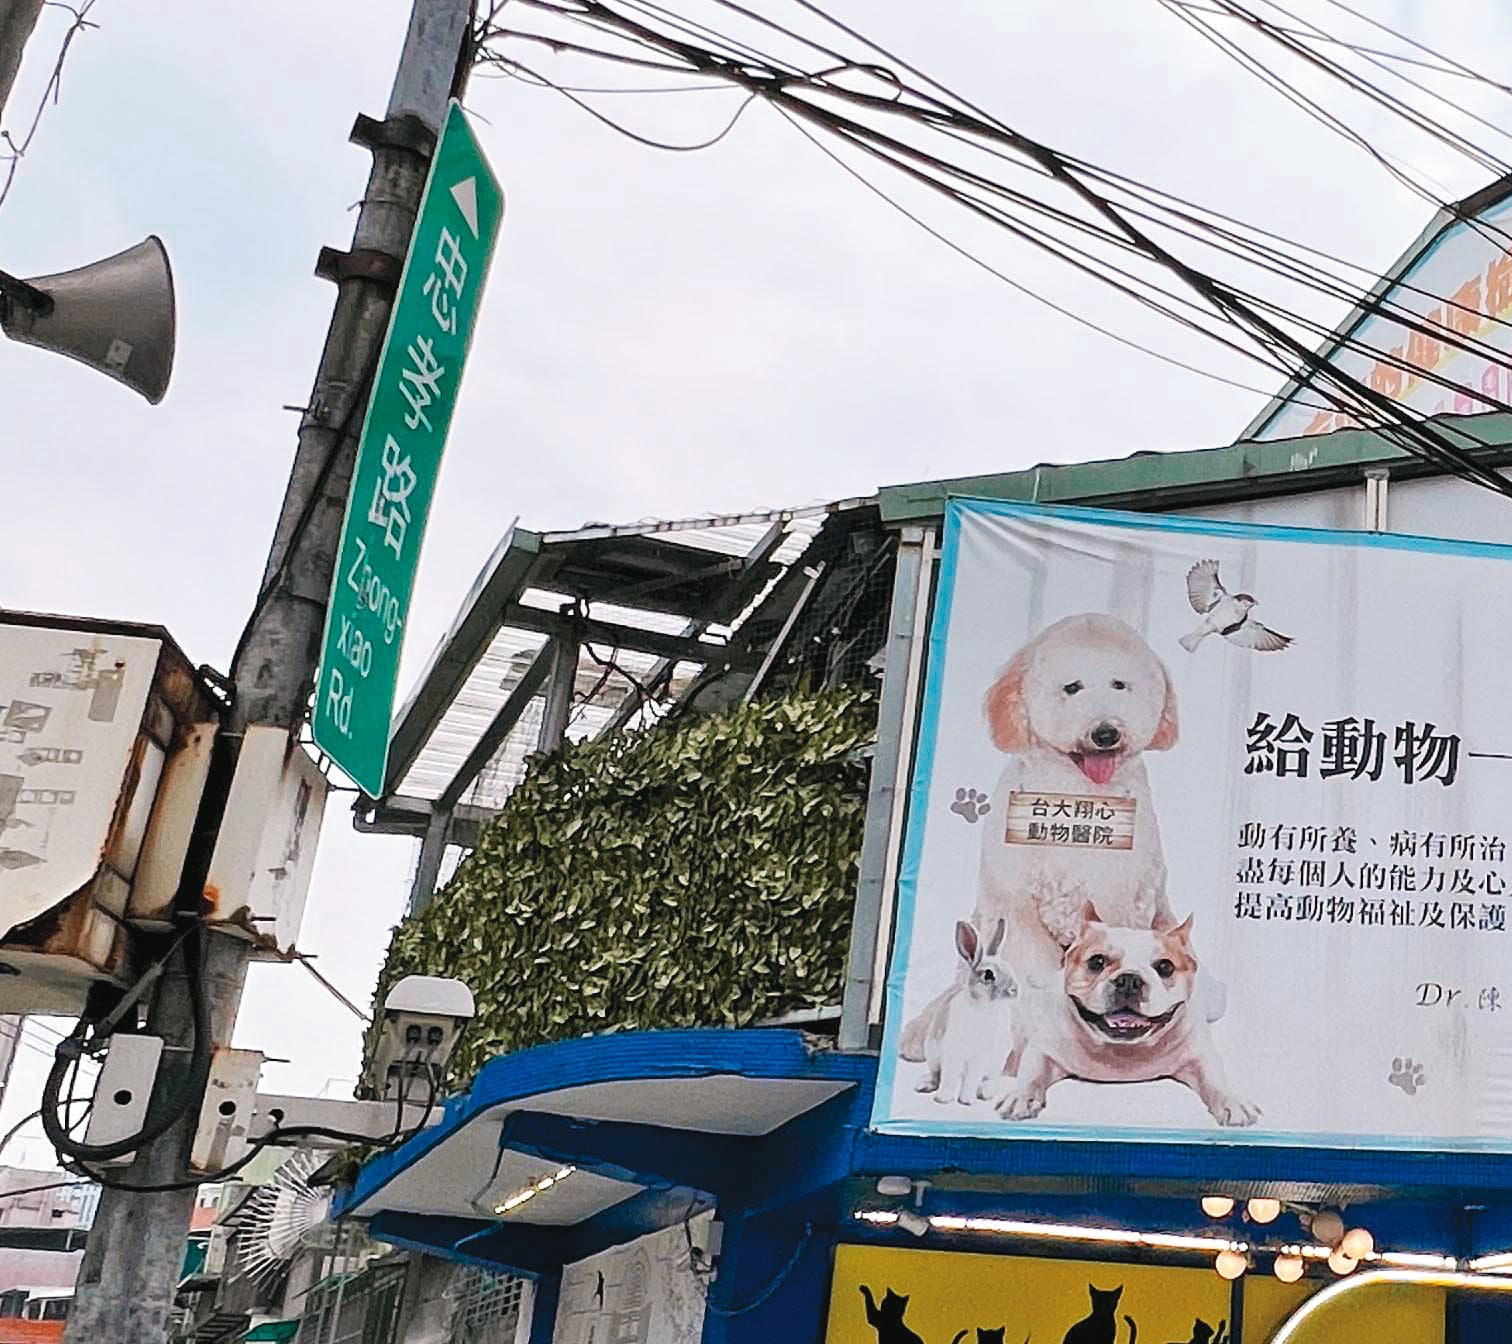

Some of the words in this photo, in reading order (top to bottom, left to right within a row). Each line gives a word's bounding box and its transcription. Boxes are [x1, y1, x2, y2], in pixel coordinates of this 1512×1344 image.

[368, 232, 469, 561] 忠孝路
[336, 613, 373, 678] xiao
[326, 667, 354, 740] Rd.
[1027, 822, 1114, 845] 動物醫院
[1031, 798, 1116, 820] 台大翔心
